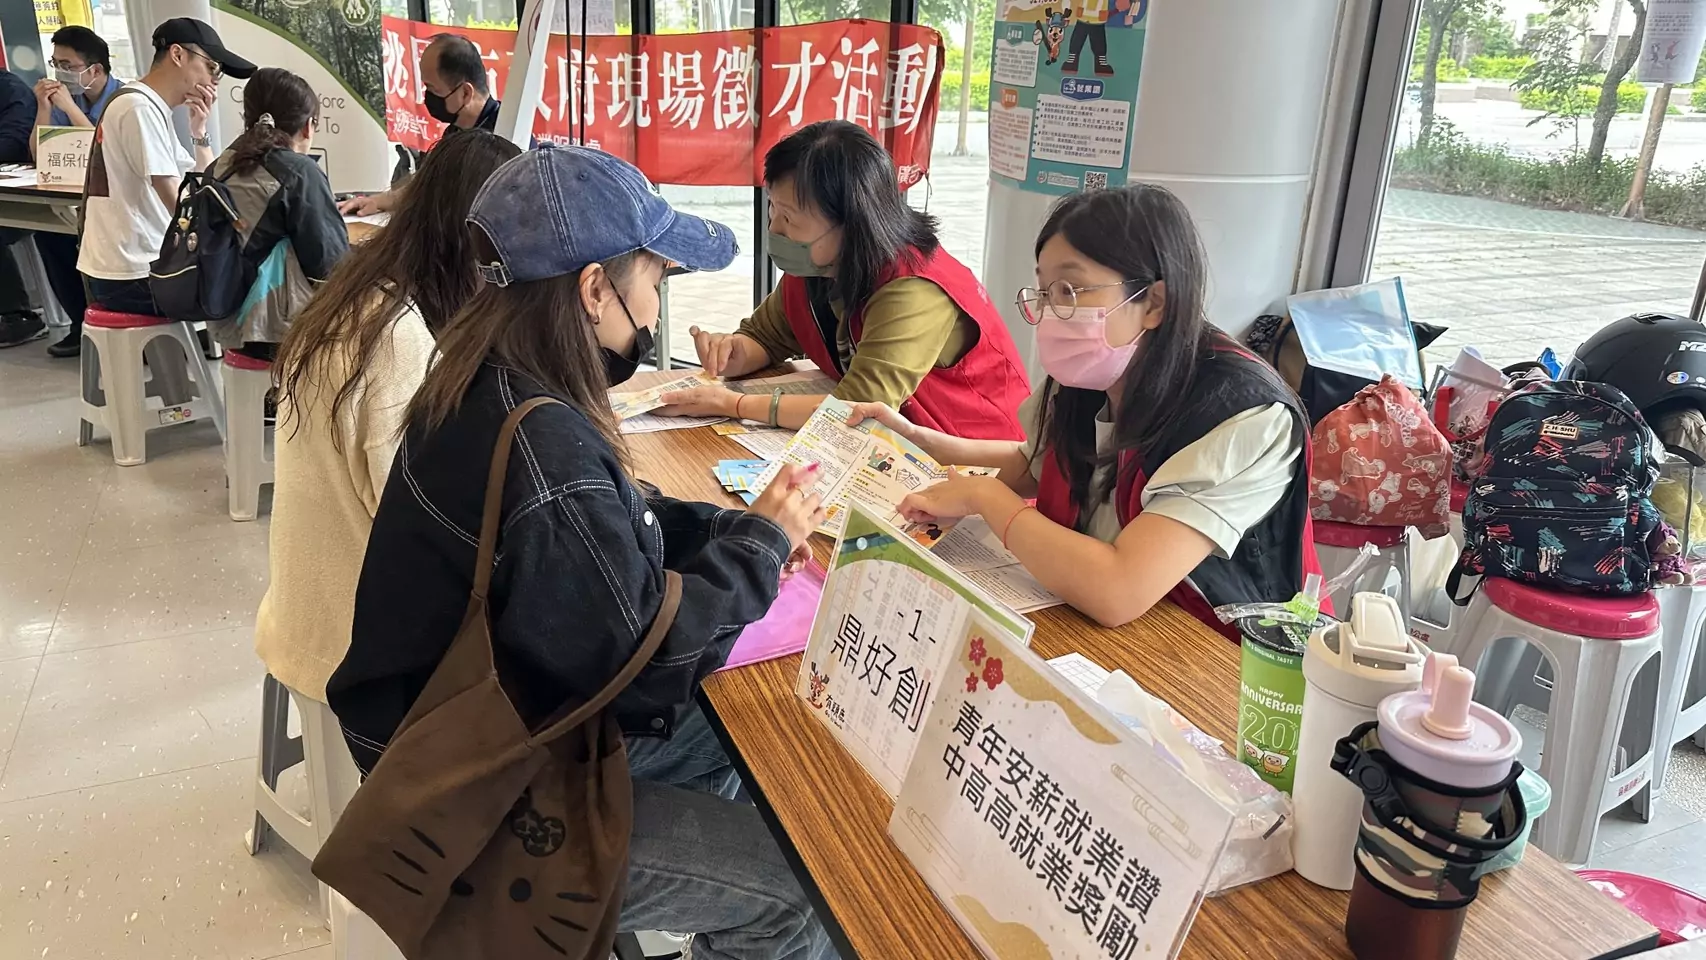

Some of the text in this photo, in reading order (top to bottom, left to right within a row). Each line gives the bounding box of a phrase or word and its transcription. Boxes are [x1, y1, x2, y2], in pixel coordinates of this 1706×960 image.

[323, 116, 340, 135] To
[830, 612, 931, 733] 鼎好創
[1241, 680, 1303, 715] ANNIVERSAR
[1259, 685, 1284, 699] HAPPY
[951, 700, 1162, 924] 青年安薪就業讚
[941, 743, 1138, 960] 中高高就業獎勵
